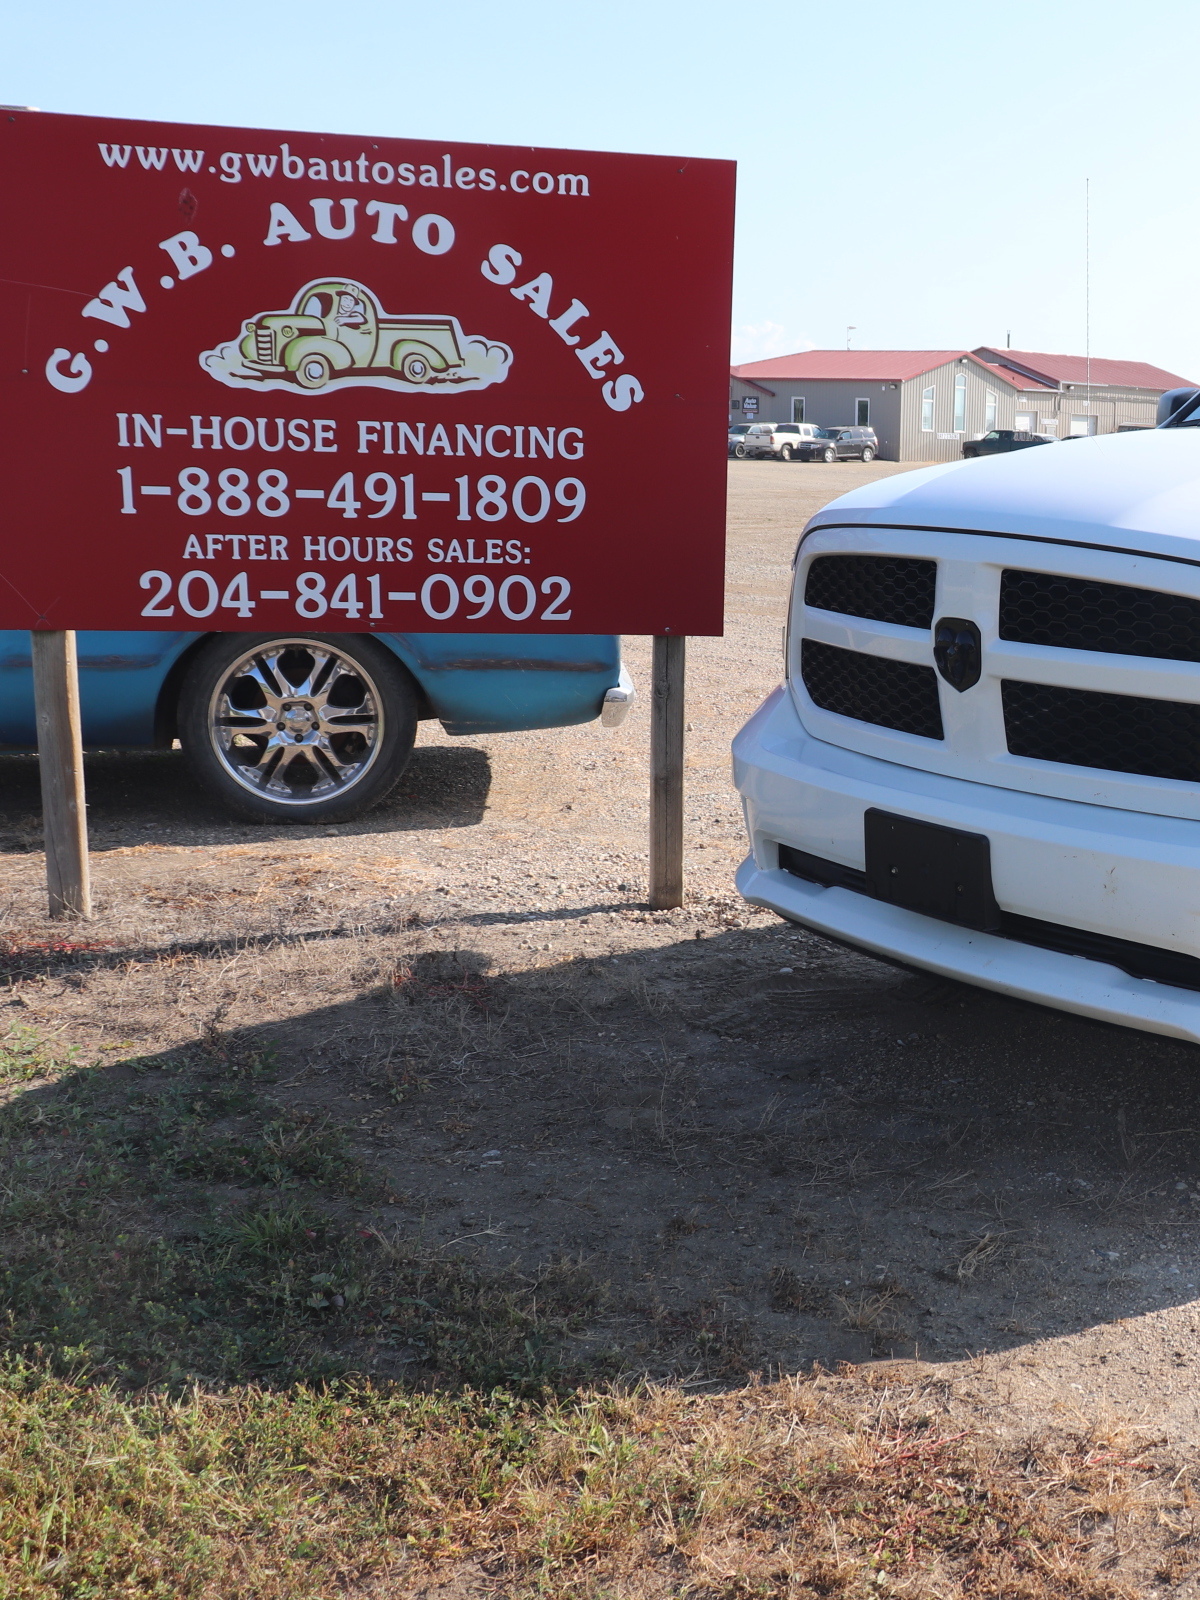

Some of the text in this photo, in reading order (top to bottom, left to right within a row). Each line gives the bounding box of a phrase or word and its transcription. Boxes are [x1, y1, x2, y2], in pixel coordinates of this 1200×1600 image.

[97, 142, 590, 197] www.gwbautosales.com
[45, 197, 645, 412] G.W.B. AUTO SALES
[115, 412, 584, 460] IN-HOUSE FINANCING
[116, 465, 587, 524] 1-888-491-1809
[182, 533, 531, 565] AFTER HOURS SALES:
[139, 569, 572, 621] 204-841-0902
